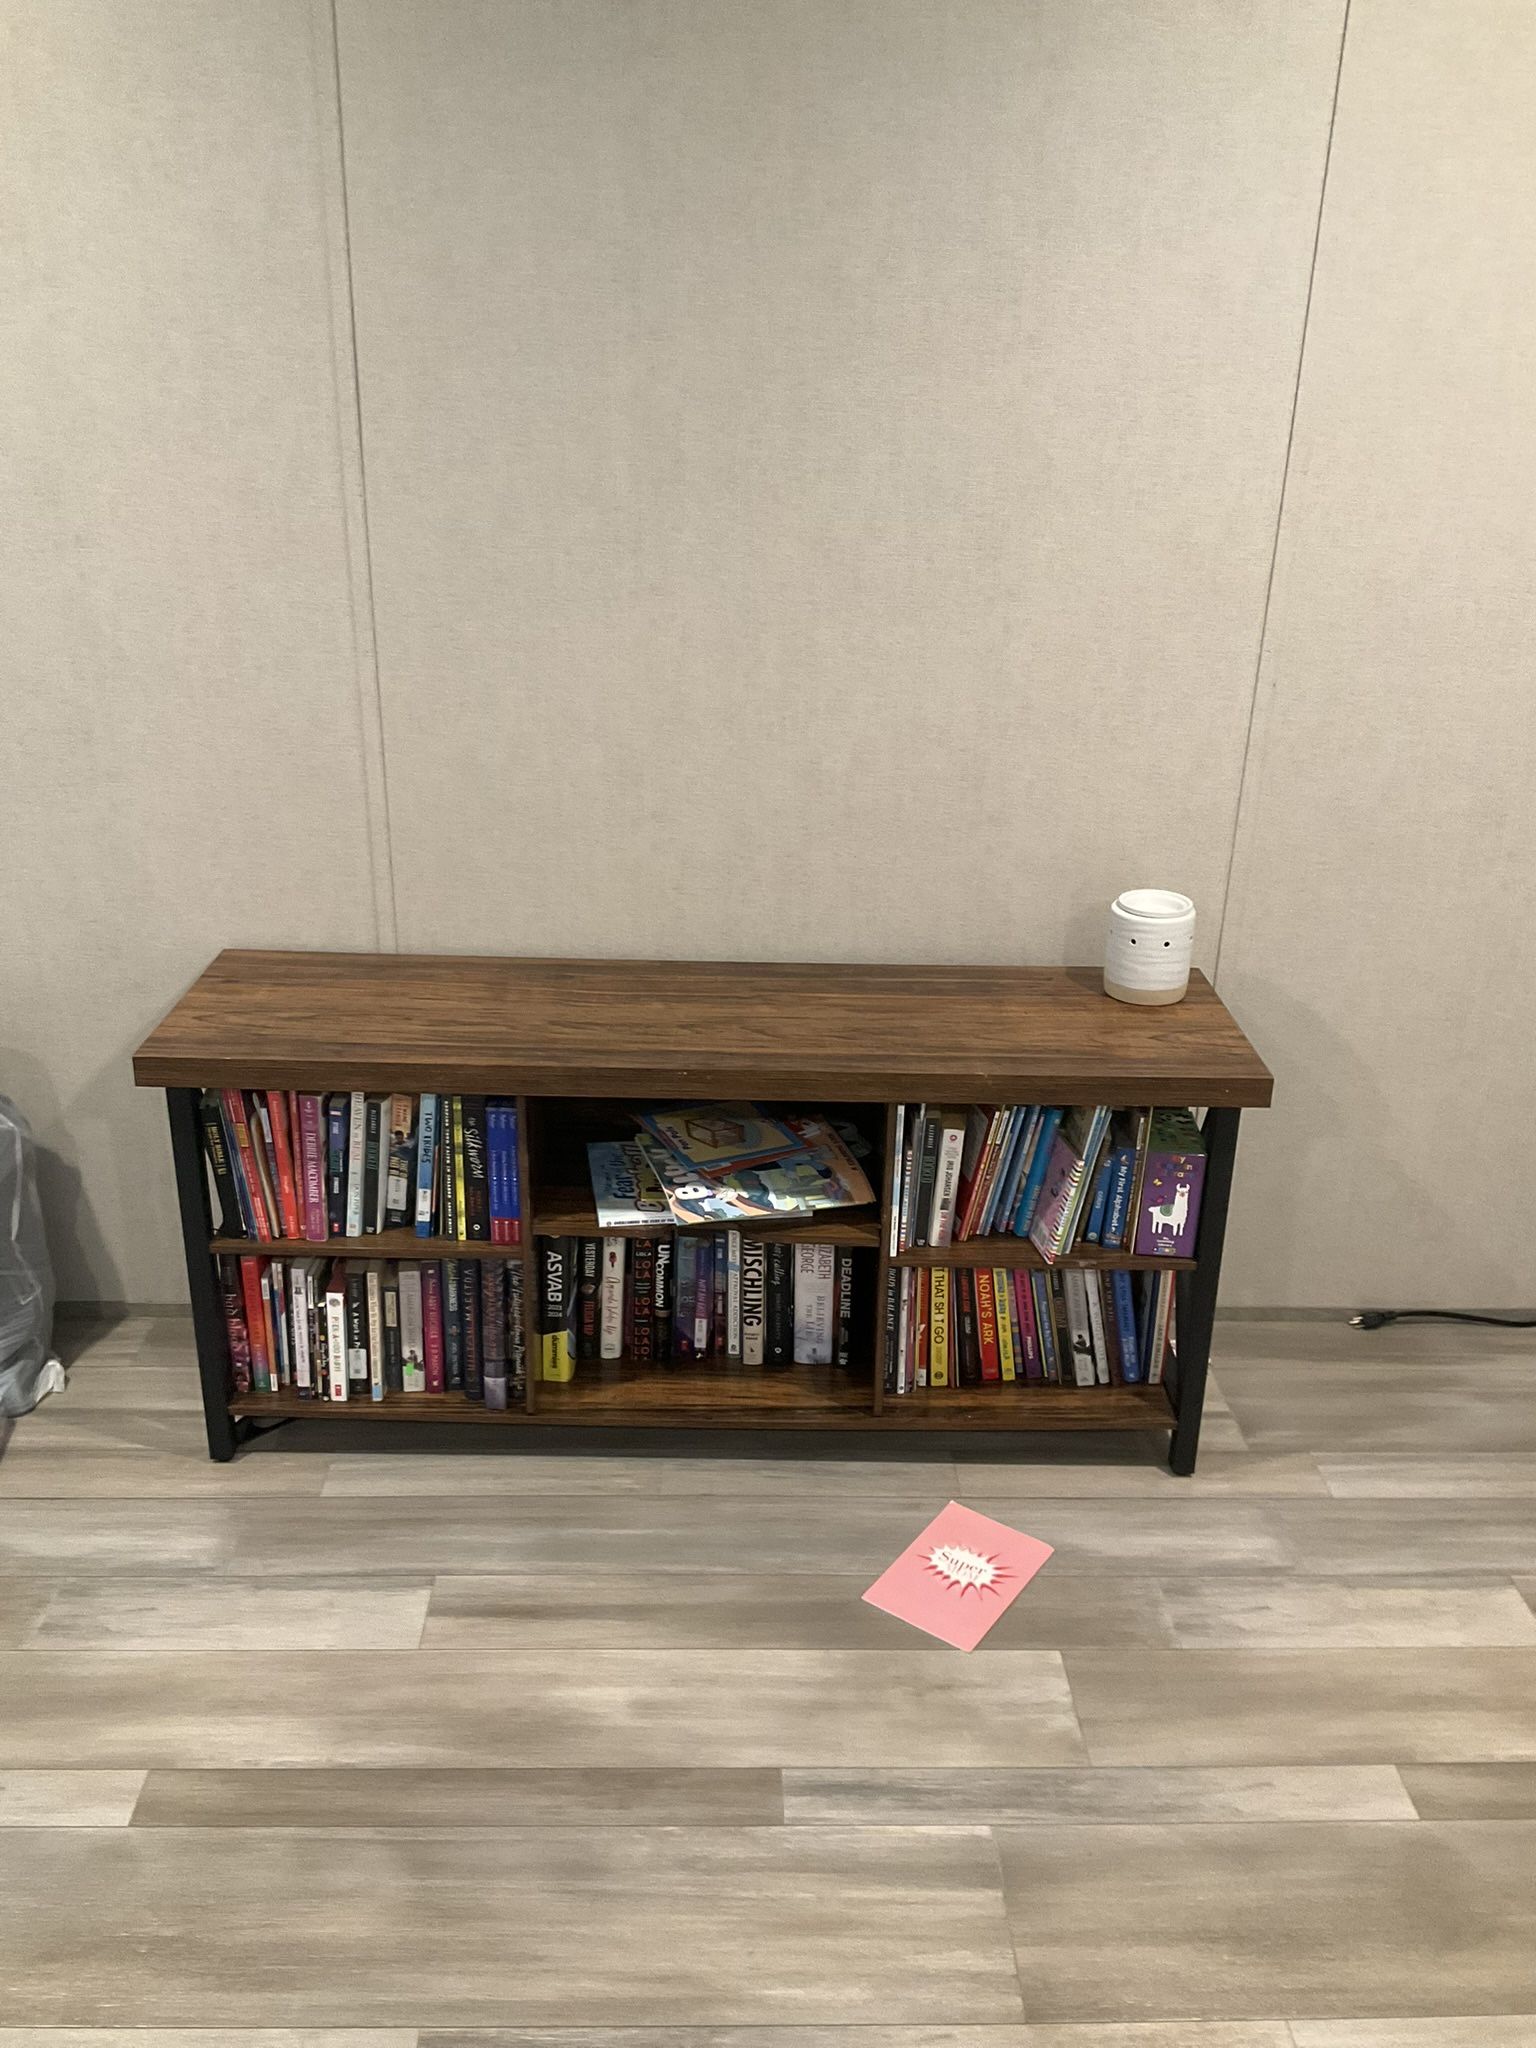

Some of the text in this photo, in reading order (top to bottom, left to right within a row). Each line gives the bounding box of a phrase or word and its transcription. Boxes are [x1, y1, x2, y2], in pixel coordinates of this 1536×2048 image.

[305, 1132, 317, 1159] DEBBIE
[421, 1111, 433, 1163] TWO TRIBES
[307, 1160, 319, 1203] MACOMBER
[613, 1174, 636, 1199] Fear
[1111, 1165, 1128, 1226] My First Alphabet
[547, 1251, 562, 1303] ASVAB
[584, 1242, 595, 1277] YESTERDAY
[655, 1244, 671, 1308] UNCOMMON
[818, 1245, 832, 1280] IZABETH
[744, 1241, 762, 1326] MISCHLING
[840, 1258, 852, 1319] DEADLINE
[934, 1275, 944, 1299] THAT
[934, 1302, 944, 1323] SHT
[979, 1274, 994, 1345] NOAH'S ARK
[552, 1335, 561, 1369] dummies
[934, 1326, 945, 1344] GO
[938, 1551, 987, 1576] Super
